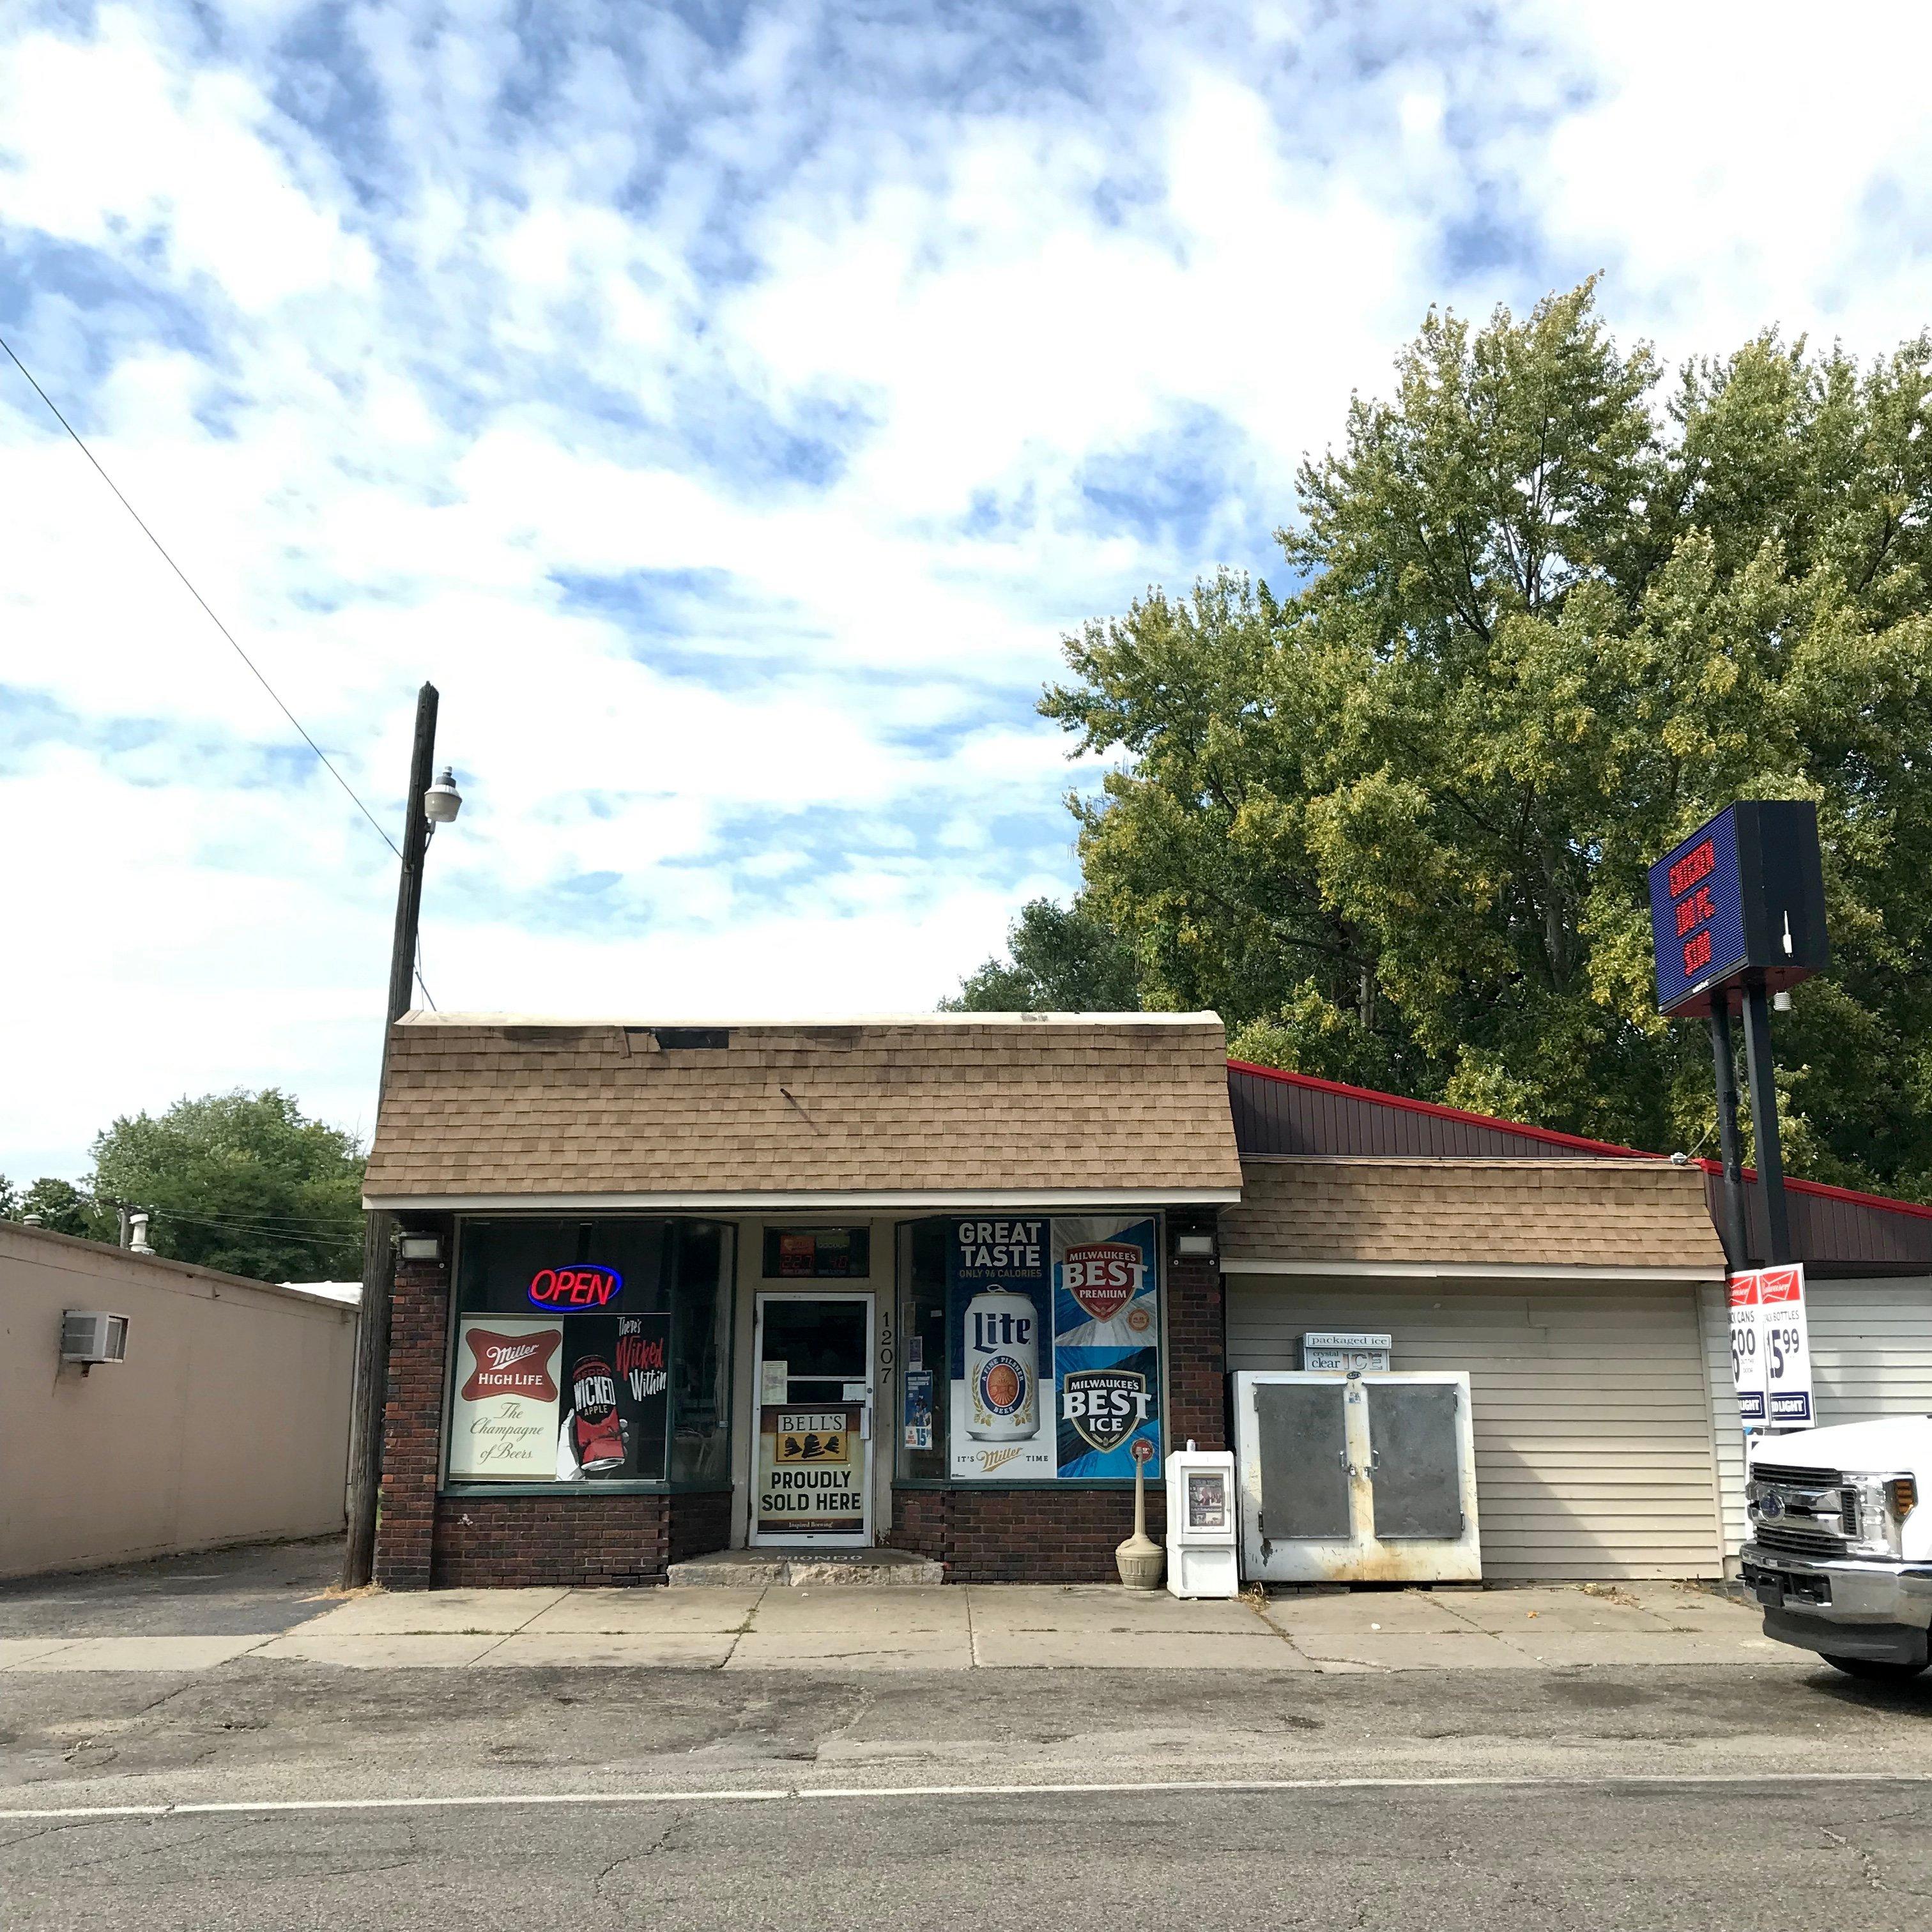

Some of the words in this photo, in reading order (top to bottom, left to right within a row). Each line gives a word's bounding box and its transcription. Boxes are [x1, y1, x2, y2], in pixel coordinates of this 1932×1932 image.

[959, 1222, 1041, 1243] GREAT
[960, 1245, 1041, 1267] TASTE
[1070, 1250, 1137, 1262] MILWAUKEE'S
[960, 1269, 983, 1278] ONLY
[985, 1269, 995, 1278] 96
[997, 1269, 1043, 1278] CALORIES
[1061, 1261, 1149, 1290] BEST
[532, 1269, 613, 1305] OPEN
[1080, 1289, 1127, 1298] PREMIUM
[1737, 1310, 1755, 1324] CANS
[1773, 1310, 1800, 1322] BOTTLES
[617, 1316, 642, 1337] There's
[972, 1312, 1031, 1354] Lite
[1312, 1336, 1367, 1346] packaged
[1371, 1337, 1388, 1345] ice
[486, 1344, 540, 1368] Miller
[615, 1336, 664, 1382] Wicked
[1312, 1358, 1340, 1368] clear
[1342, 1351, 1383, 1370] ICE
[479, 1373, 512, 1385] HIGH
[515, 1374, 544, 1386] LIFE
[629, 1368, 667, 1402] Within
[1071, 1379, 1139, 1390] MILWAUKEE'S
[574, 1376, 617, 1412] WICKED
[493, 1401, 524, 1419] The
[584, 1404, 608, 1416] APPLE
[993, 1406, 1015, 1414] BEER
[1061, 1389, 1152, 1420] BEST
[1779, 1400, 1804, 1413] LIGHT
[470, 1416, 544, 1441] Champagne
[783, 1415, 843, 1432] BELL'S
[1089, 1418, 1124, 1432] ICE
[477, 1443, 494, 1466] of
[976, 1446, 1023, 1470] Miller
[770, 1470, 852, 1489] PROUDLY
[762, 1492, 809, 1512] SOLD
[816, 1492, 862, 1511] HERE
